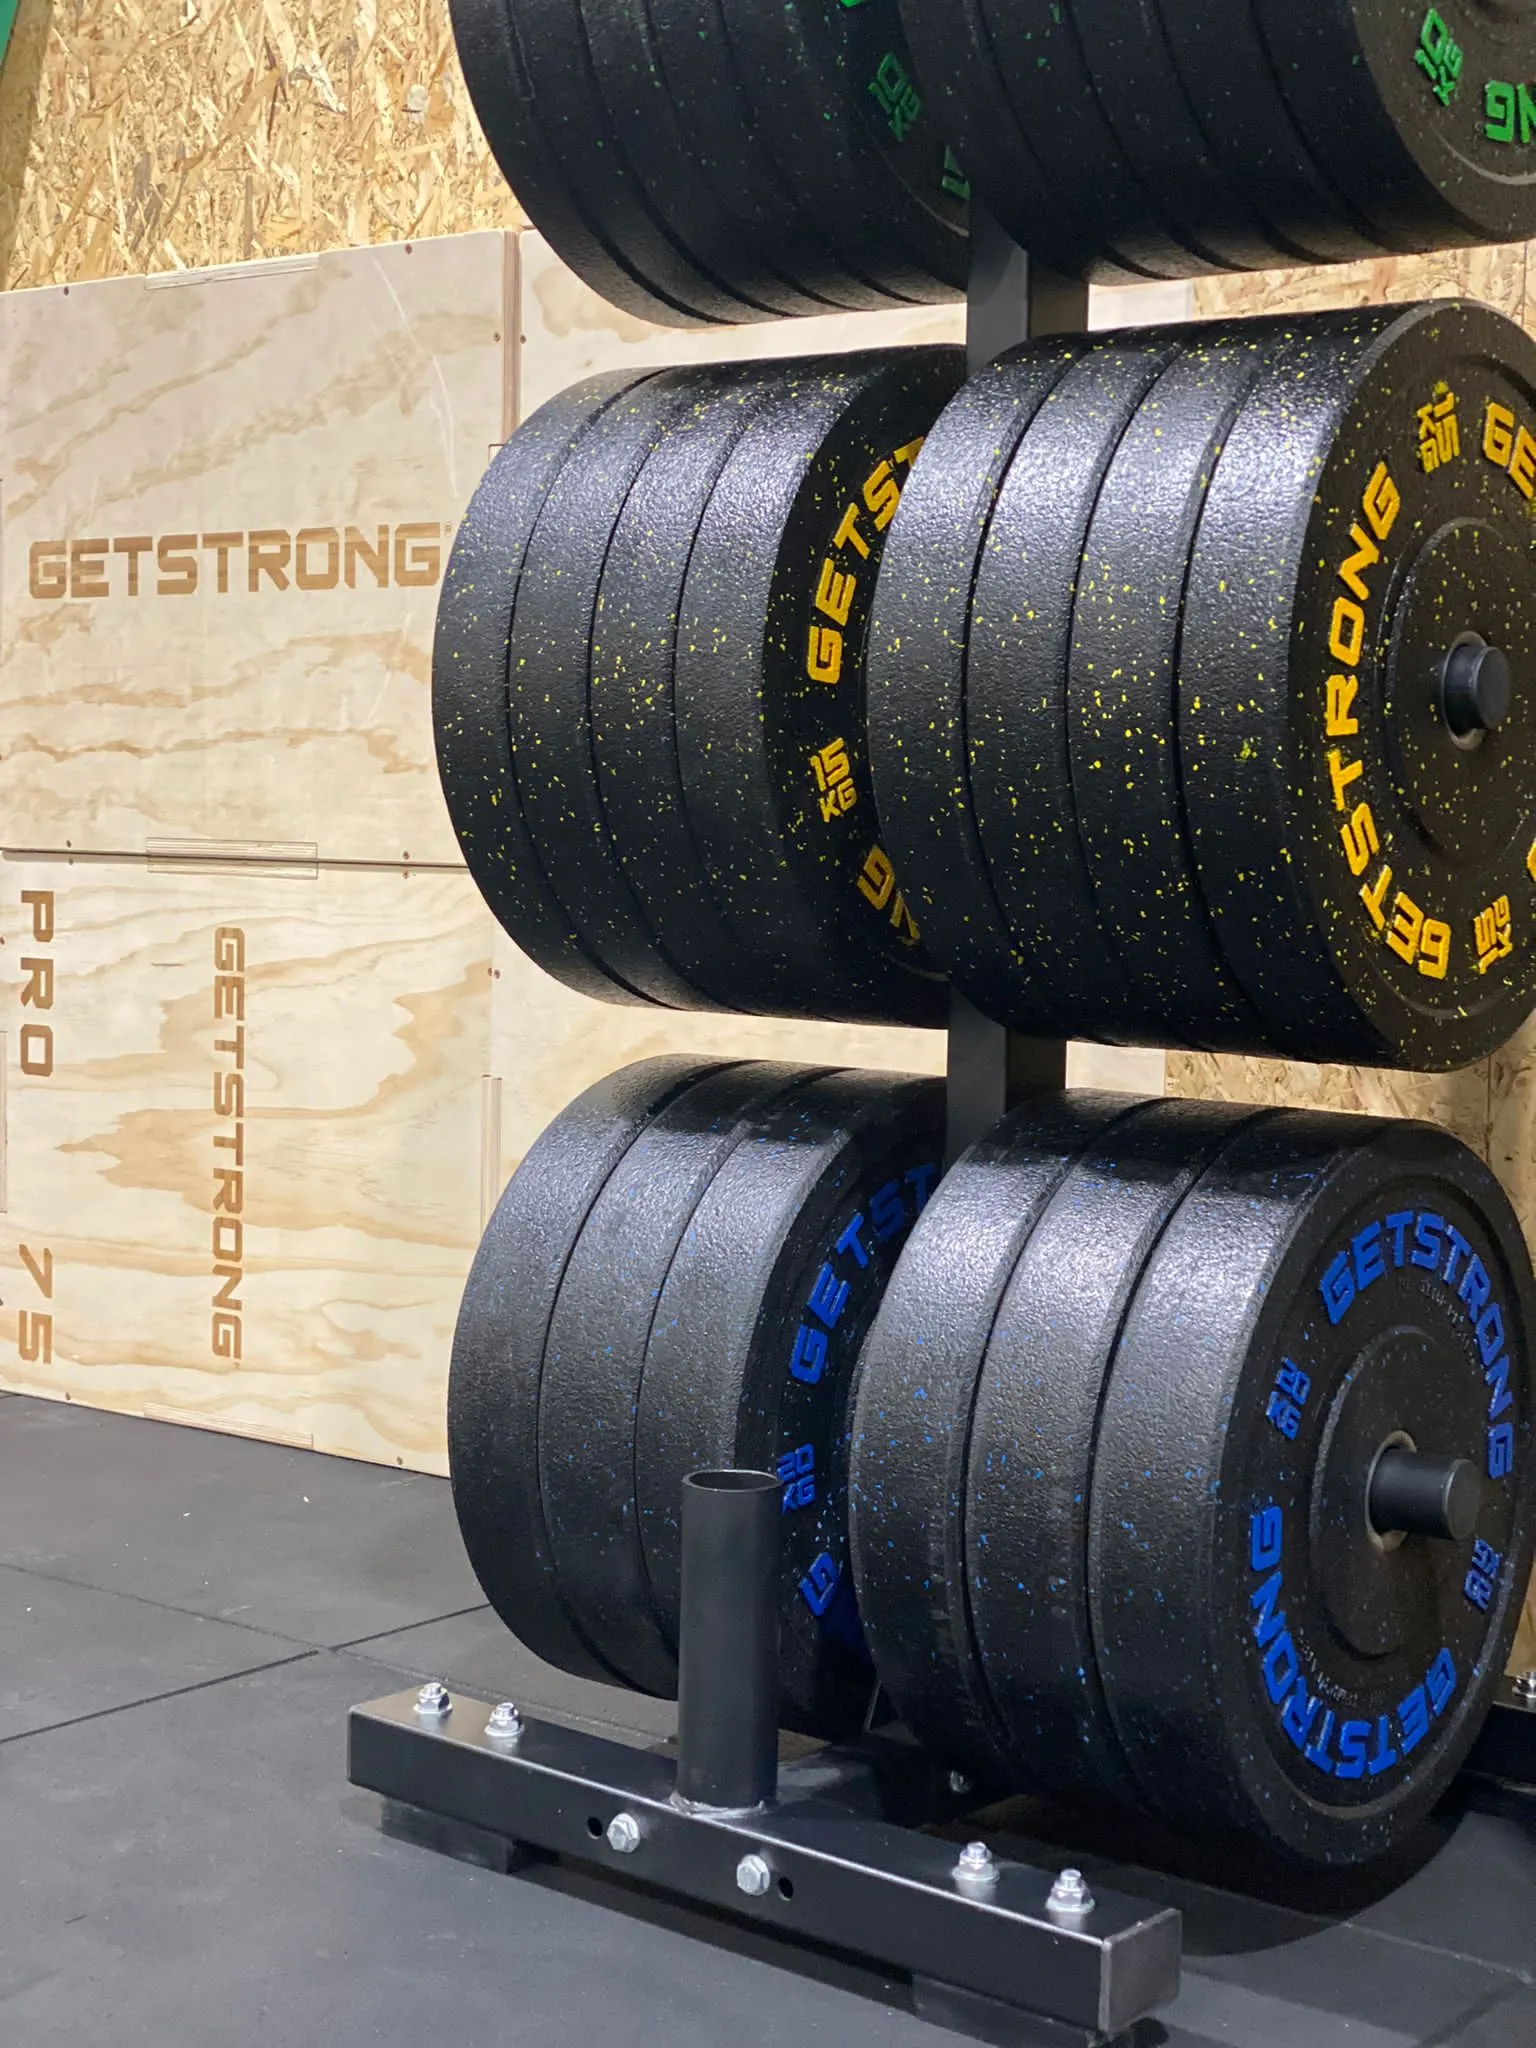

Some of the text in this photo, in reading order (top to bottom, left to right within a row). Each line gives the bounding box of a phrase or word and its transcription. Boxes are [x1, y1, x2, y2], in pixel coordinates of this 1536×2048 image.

[1413, 8, 1449, 80] 10
[1432, 37, 1464, 106] KG
[867, 53, 908, 115] 10
[1433, 391, 1460, 464] 15
[29, 522, 441, 599] GETSTRONG
[1325, 461, 1451, 980] GETSTRONG
[810, 737, 850, 792] 15
[818, 778, 857, 823] KG
[1473, 907, 1498, 975] 15
[1492, 894, 1513, 958] KG
[18, 890, 54, 1365] PRO 75
[212, 927, 246, 1360] GETSTRONG
[1319, 1210, 1514, 1480] GETSTRONG
[1276, 1356, 1312, 1406] 20
[1266, 1391, 1301, 1441] KG
[776, 1443, 815, 1482] 20
[781, 1474, 816, 1515] KG
[1250, 1506, 1457, 1780] GETSTRONG
